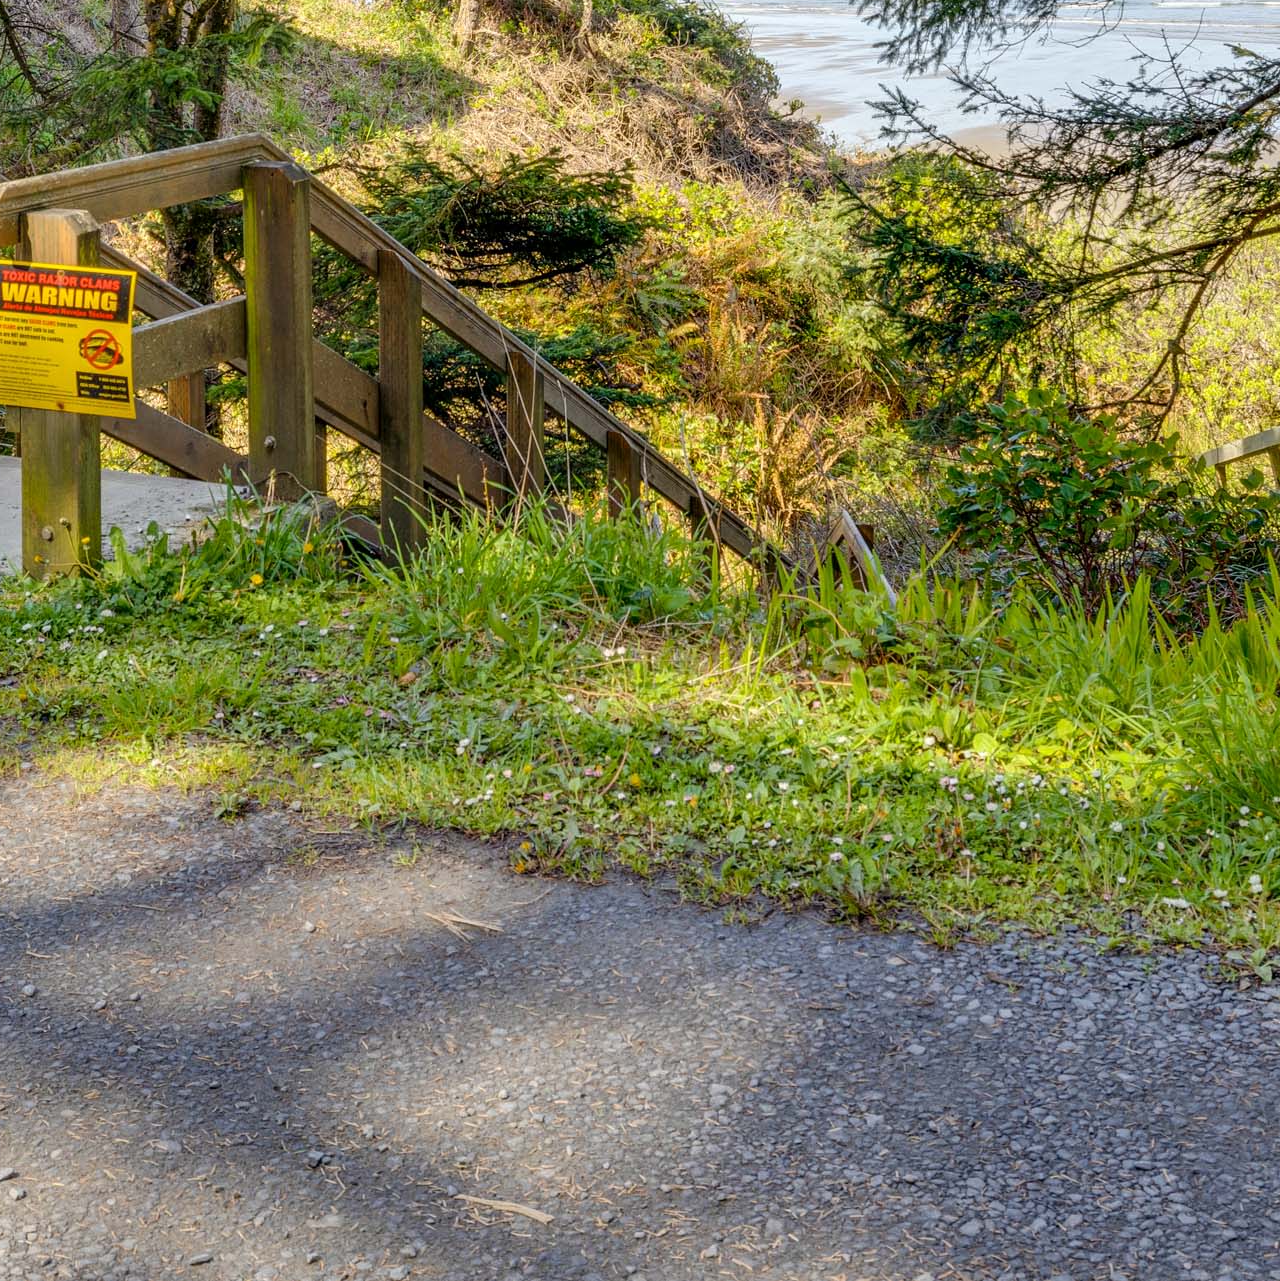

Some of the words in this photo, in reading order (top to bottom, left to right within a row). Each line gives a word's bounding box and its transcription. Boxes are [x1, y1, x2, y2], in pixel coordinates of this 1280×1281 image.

[2, 271, 36, 283] TOXIC
[38, 273, 77, 287] RAZOR
[80, 277, 120, 291] CLAMS
[1, 282, 118, 312] WARNING
